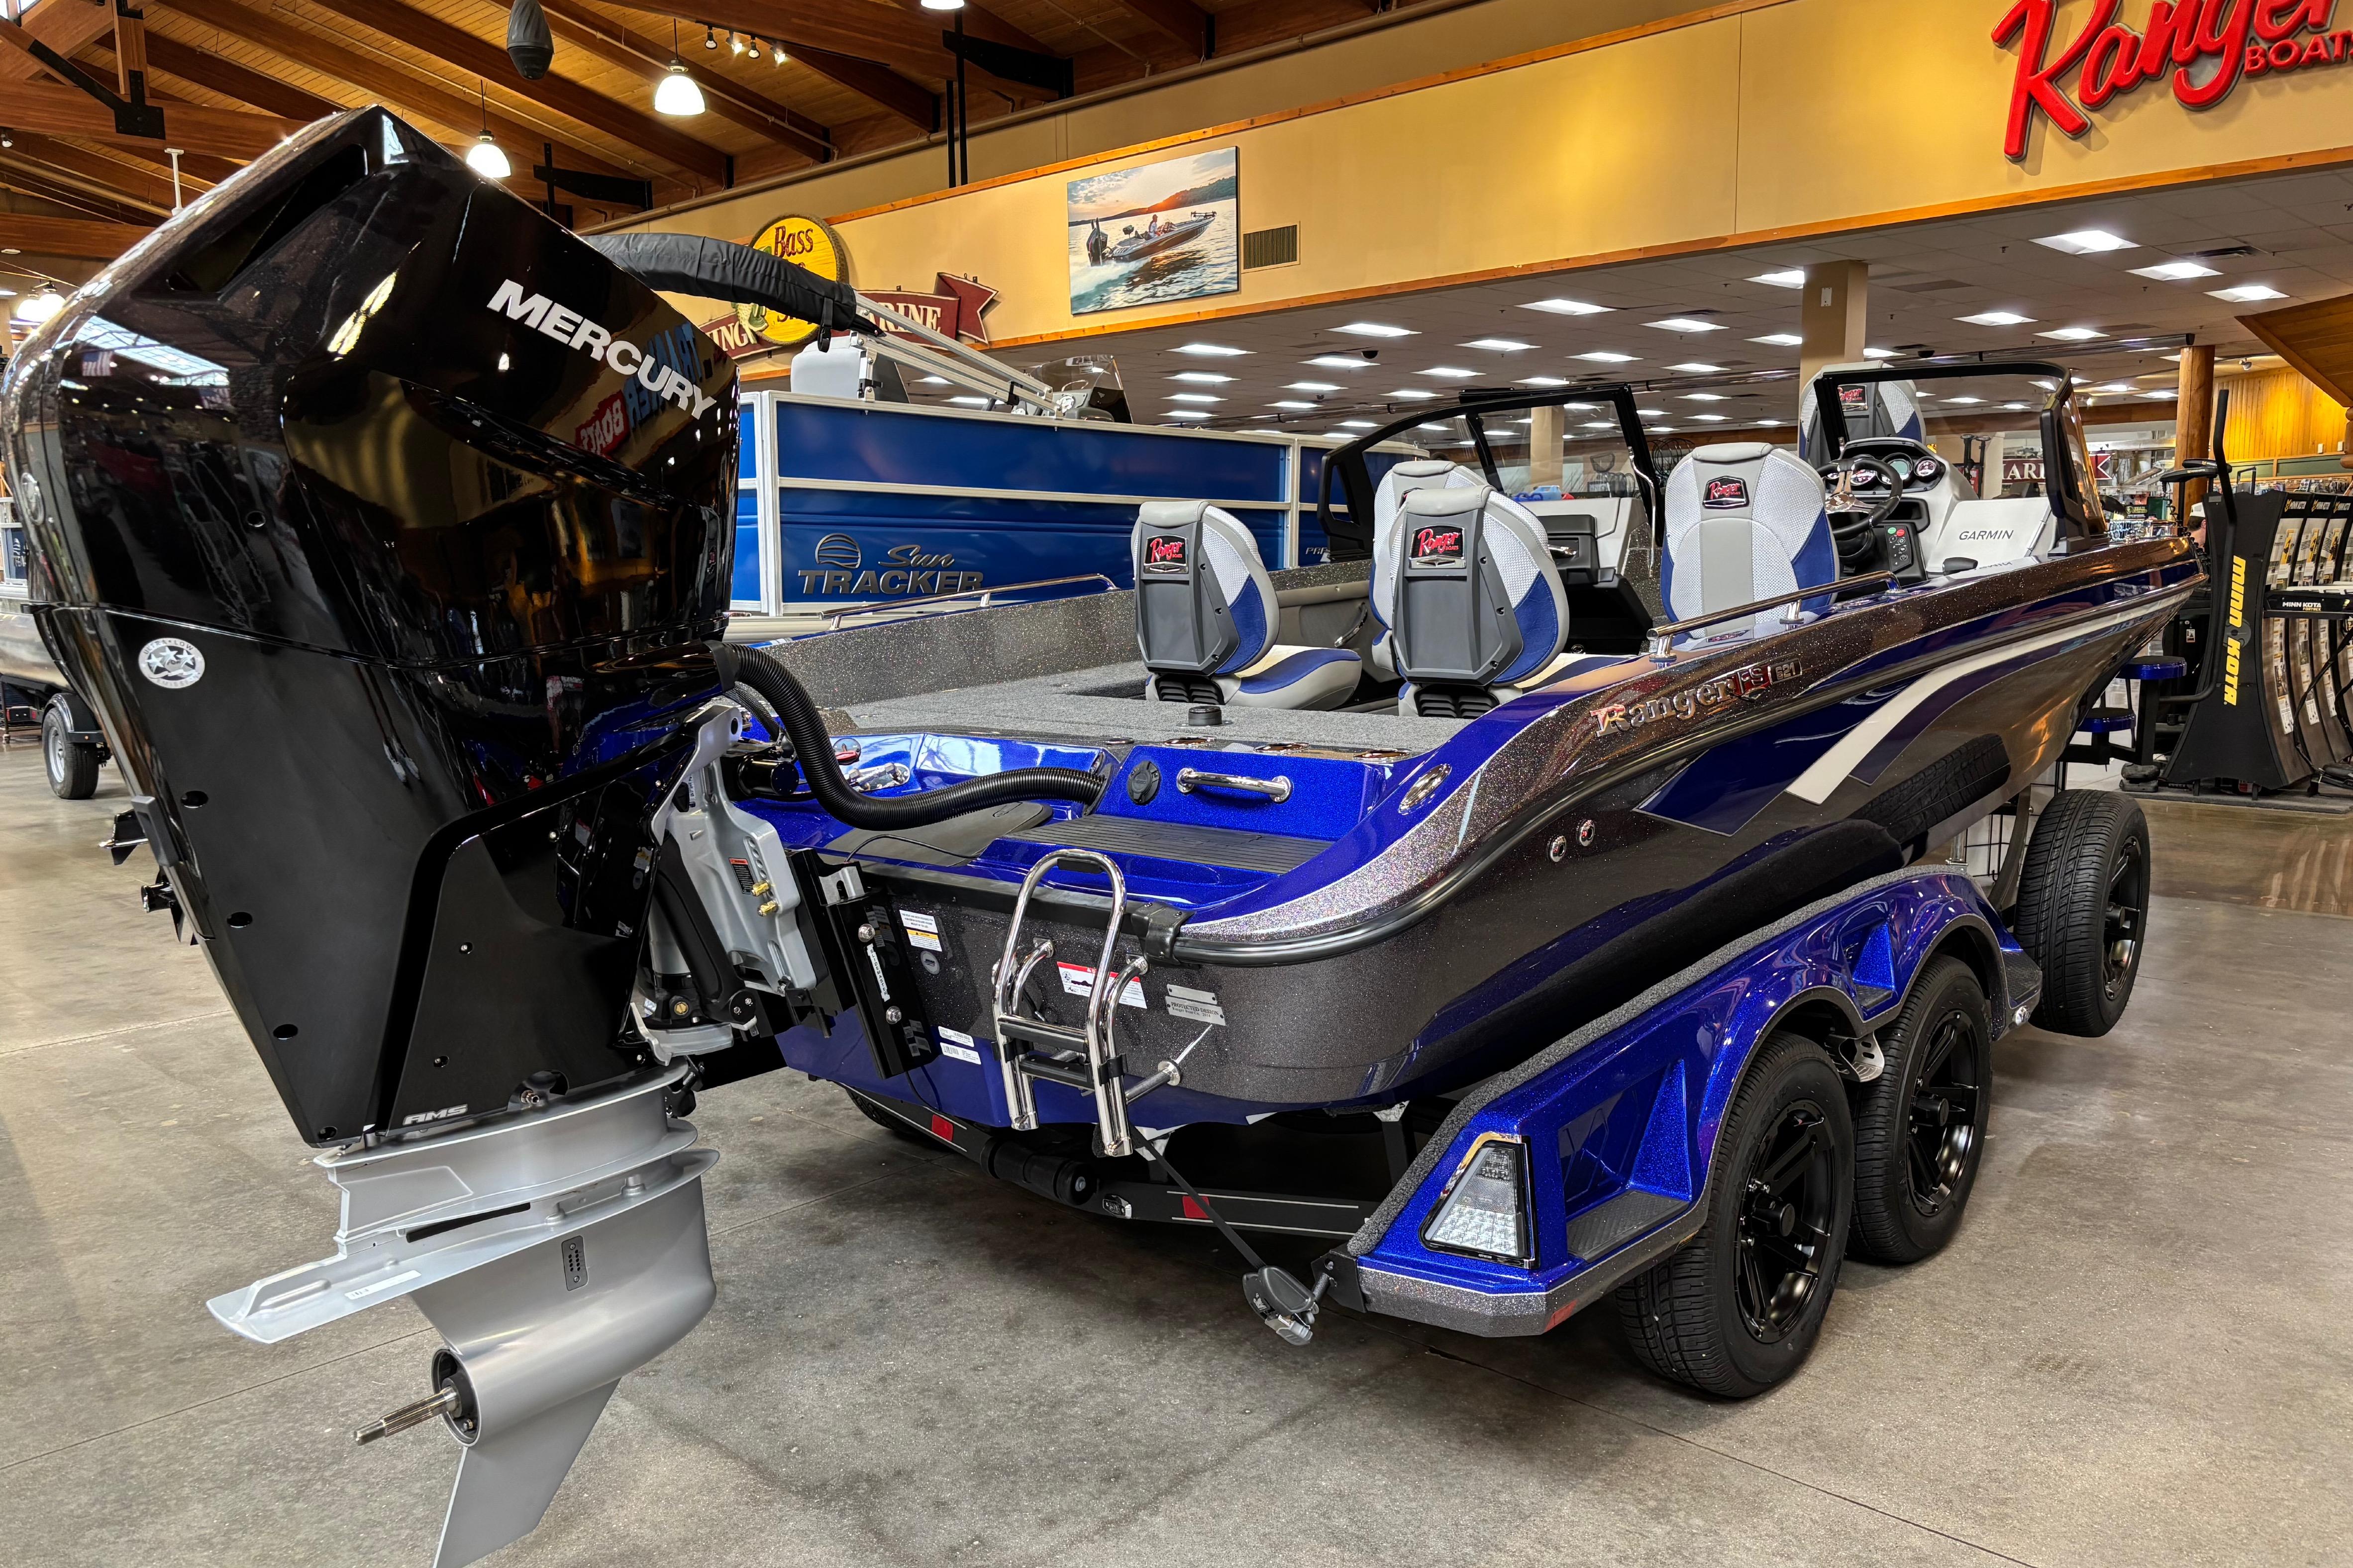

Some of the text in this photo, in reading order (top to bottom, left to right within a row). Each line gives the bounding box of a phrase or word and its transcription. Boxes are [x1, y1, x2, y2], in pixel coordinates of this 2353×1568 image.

[2244, 30, 2353, 76] BOAT
[774, 225, 814, 258] Bass
[487, 279, 716, 420] MERCURY
[1709, 482, 1741, 499] Ranger
[1418, 529, 1459, 557] Ranger
[1959, 530, 2014, 540] GARMIN
[878, 544, 955, 568] Sun
[1150, 538, 1182, 563] Ranger
[798, 570, 984, 594] TRACKER
[143, 639, 194, 655] ULTRA LOW
[1590, 663, 1797, 737] Ranger FS 621
[870, 949, 888, 995] SLIDEMASTER
[1171, 1002, 1200, 1012] PROTECTED
[403, 1104, 468, 1125] AMS
